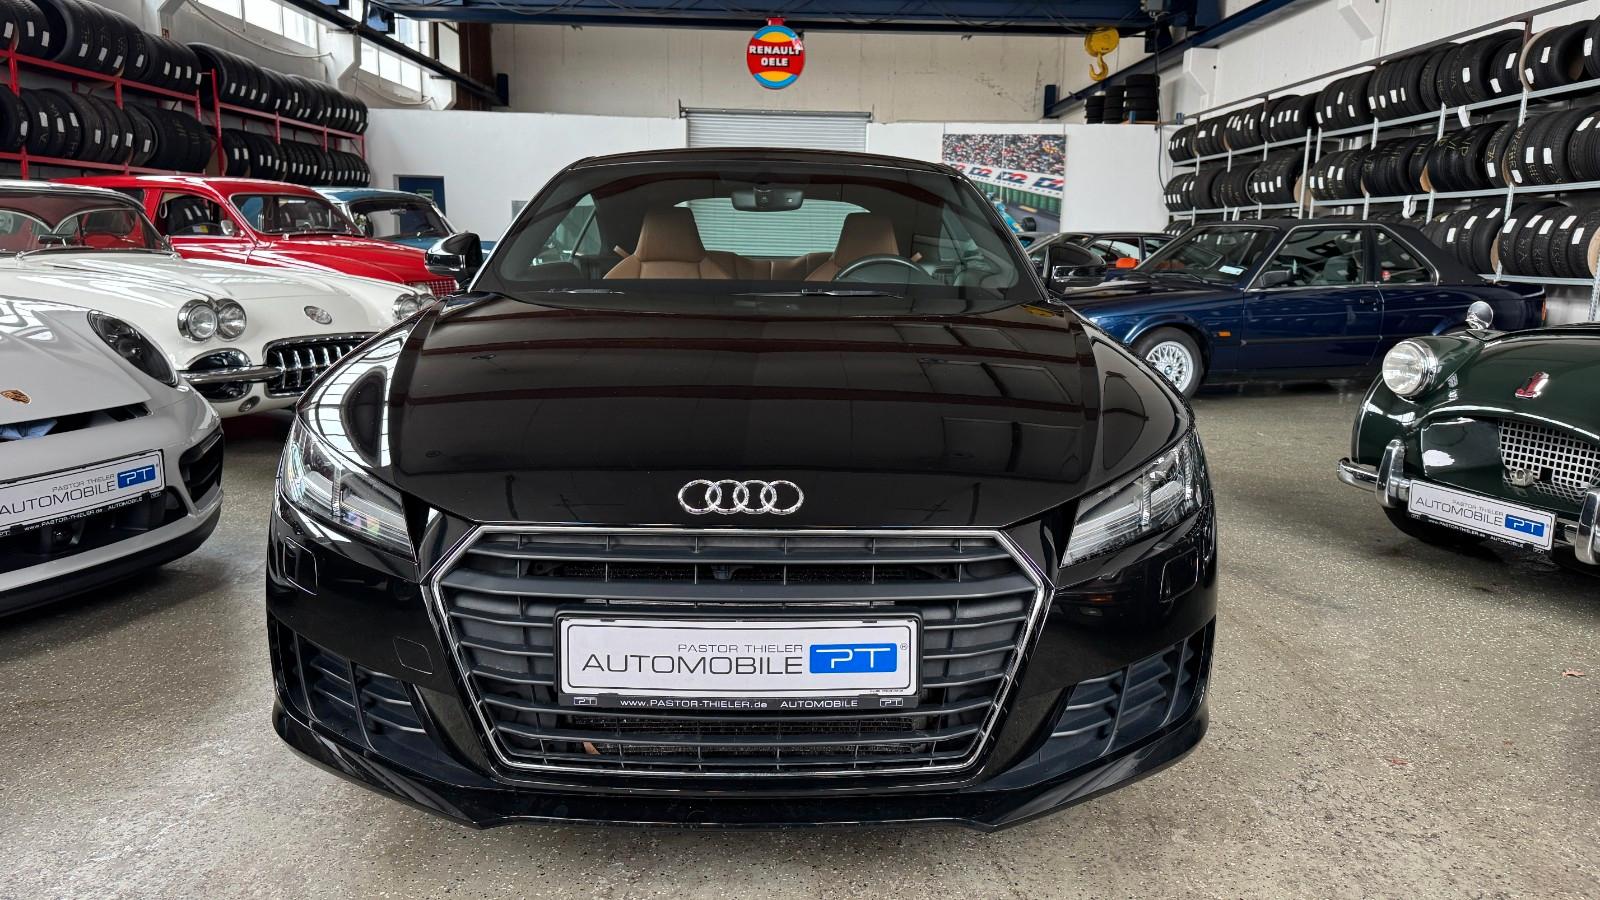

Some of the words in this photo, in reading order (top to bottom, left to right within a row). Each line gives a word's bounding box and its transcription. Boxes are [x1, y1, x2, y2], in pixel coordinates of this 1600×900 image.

[749, 45, 801, 55] RENAULT
[761, 57, 788, 67] OELE
[52, 481, 85, 492] PASTOR
[87, 473, 115, 484] THIELER
[120, 467, 153, 485] PT
[0, 480, 116, 514] AUTOMOBILE
[107, 497, 143, 510] AUTOMOBILE
[1453, 500, 1476, 510] PASTOR
[1416, 497, 1503, 526] AUTOMOBILE
[1508, 517, 1542, 533] PT
[678, 644, 738, 653] PASTOR
[744, 644, 803, 653] THIELER
[582, 654, 803, 675] AUTOMOBILE
[815, 648, 891, 669] PT
[620, 699, 768, 708] www.PASTOR-THIELER.de
[780, 699, 858, 708] AUTOMOBILE
